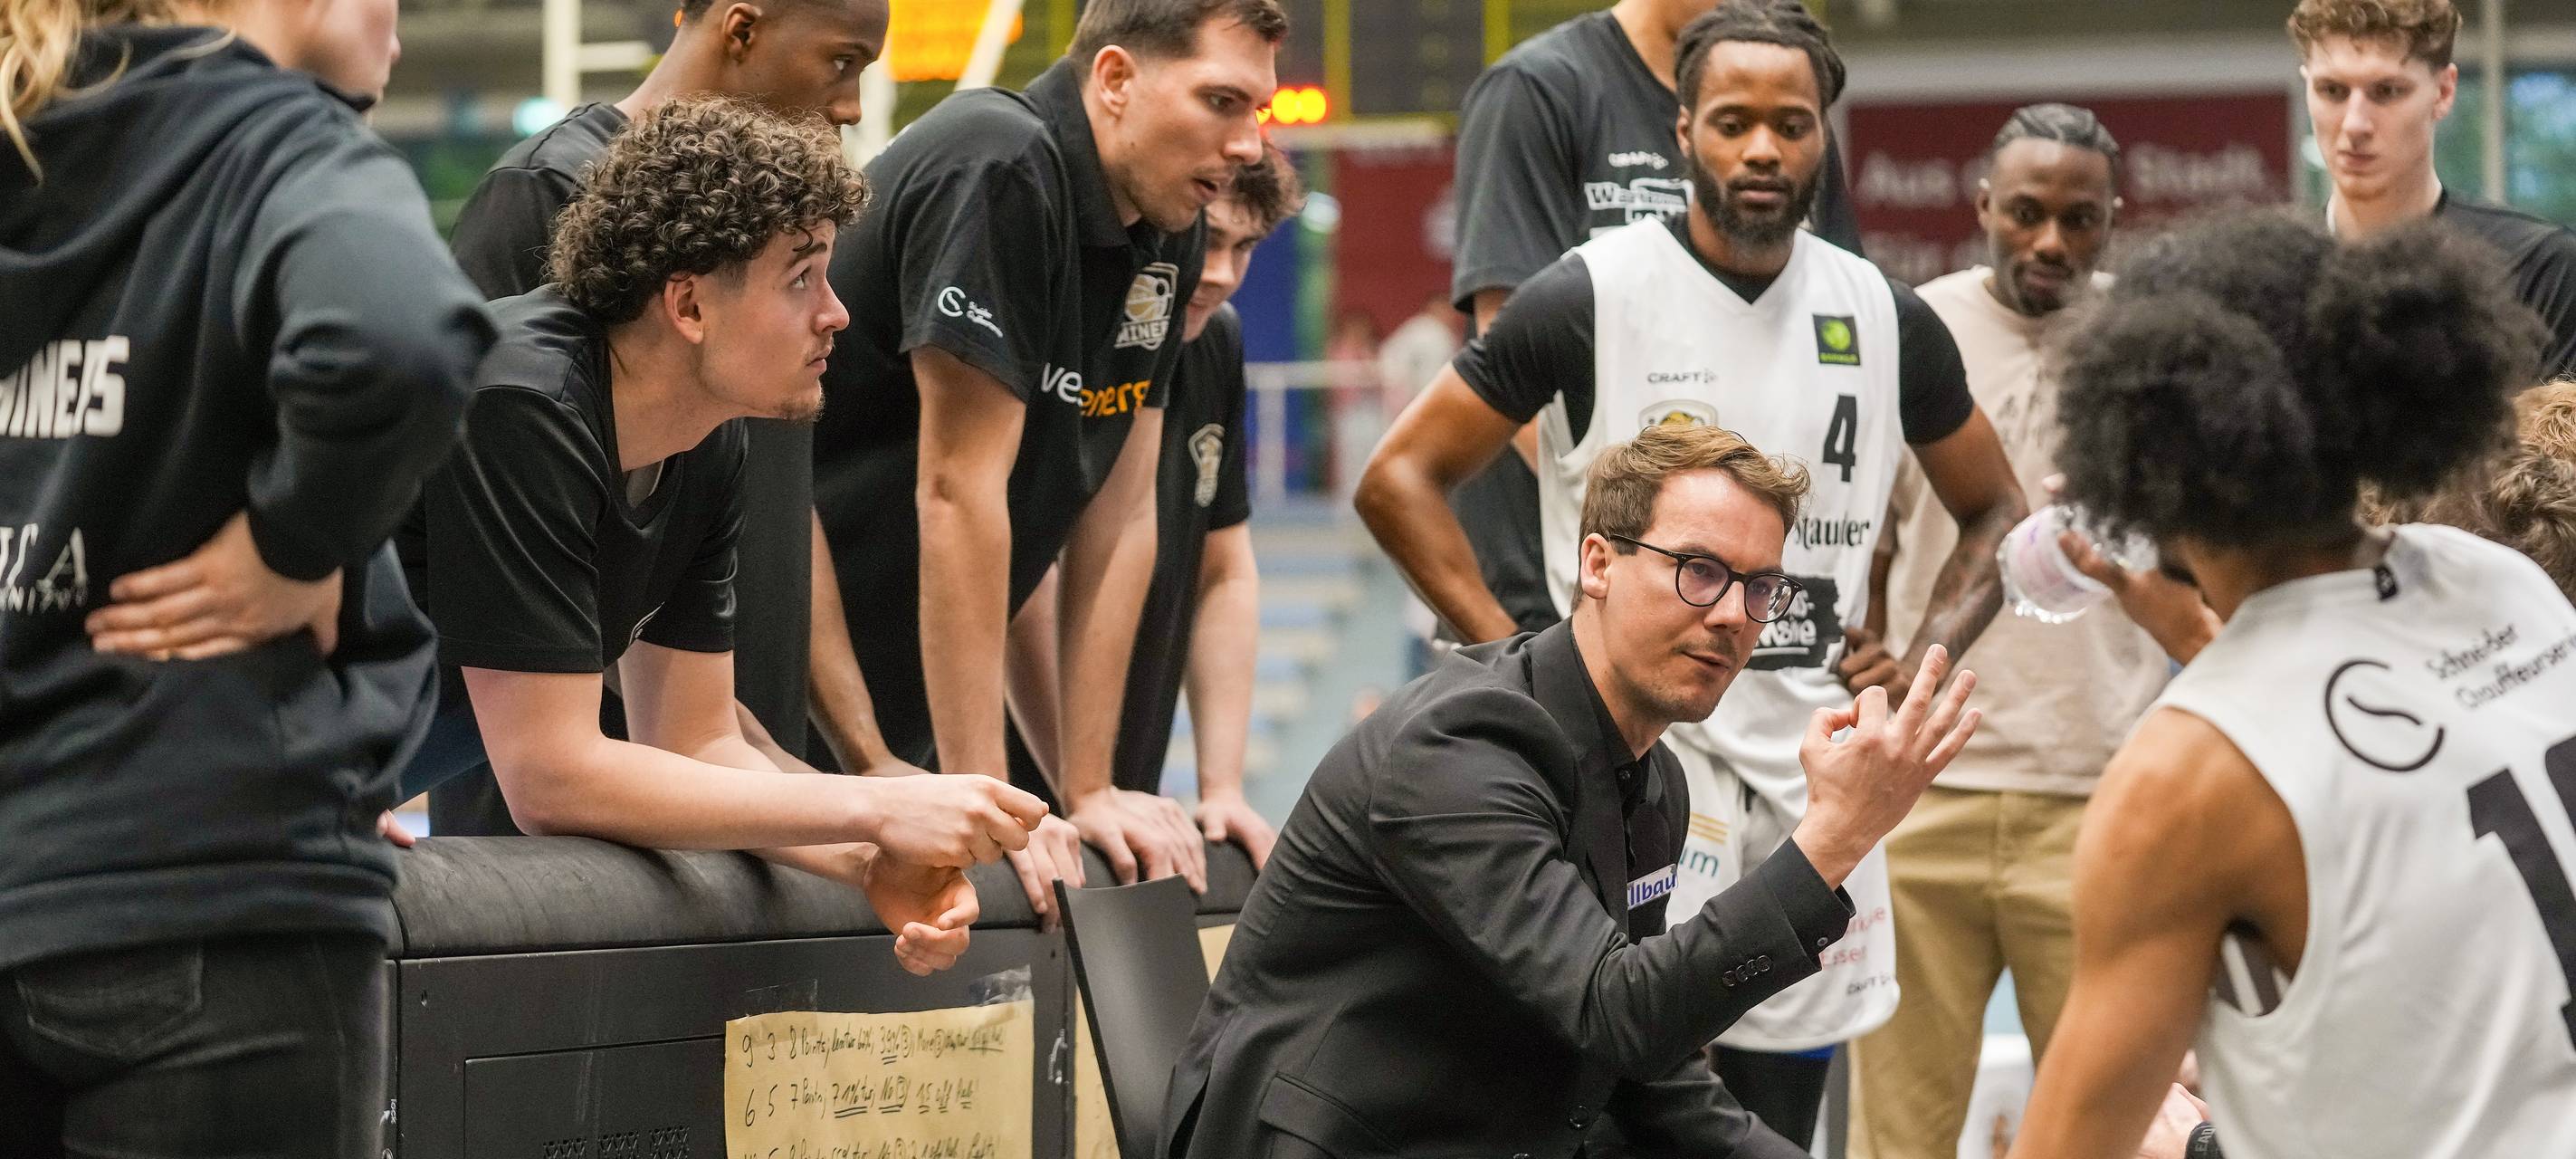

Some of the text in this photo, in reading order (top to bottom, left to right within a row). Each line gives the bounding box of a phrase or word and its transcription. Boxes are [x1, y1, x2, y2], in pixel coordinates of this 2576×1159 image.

[1647, 371, 1703, 384] CRAFT
[1822, 393, 1856, 483] 4
[1628, 873, 1677, 906] llbau
[742, 1034, 753, 1068] 9
[768, 1032, 776, 1060] 3
[789, 1025, 797, 1059] 8
[745, 1088, 755, 1126] 6
[768, 1084, 778, 1117] 5
[790, 1084, 798, 1110] 7
